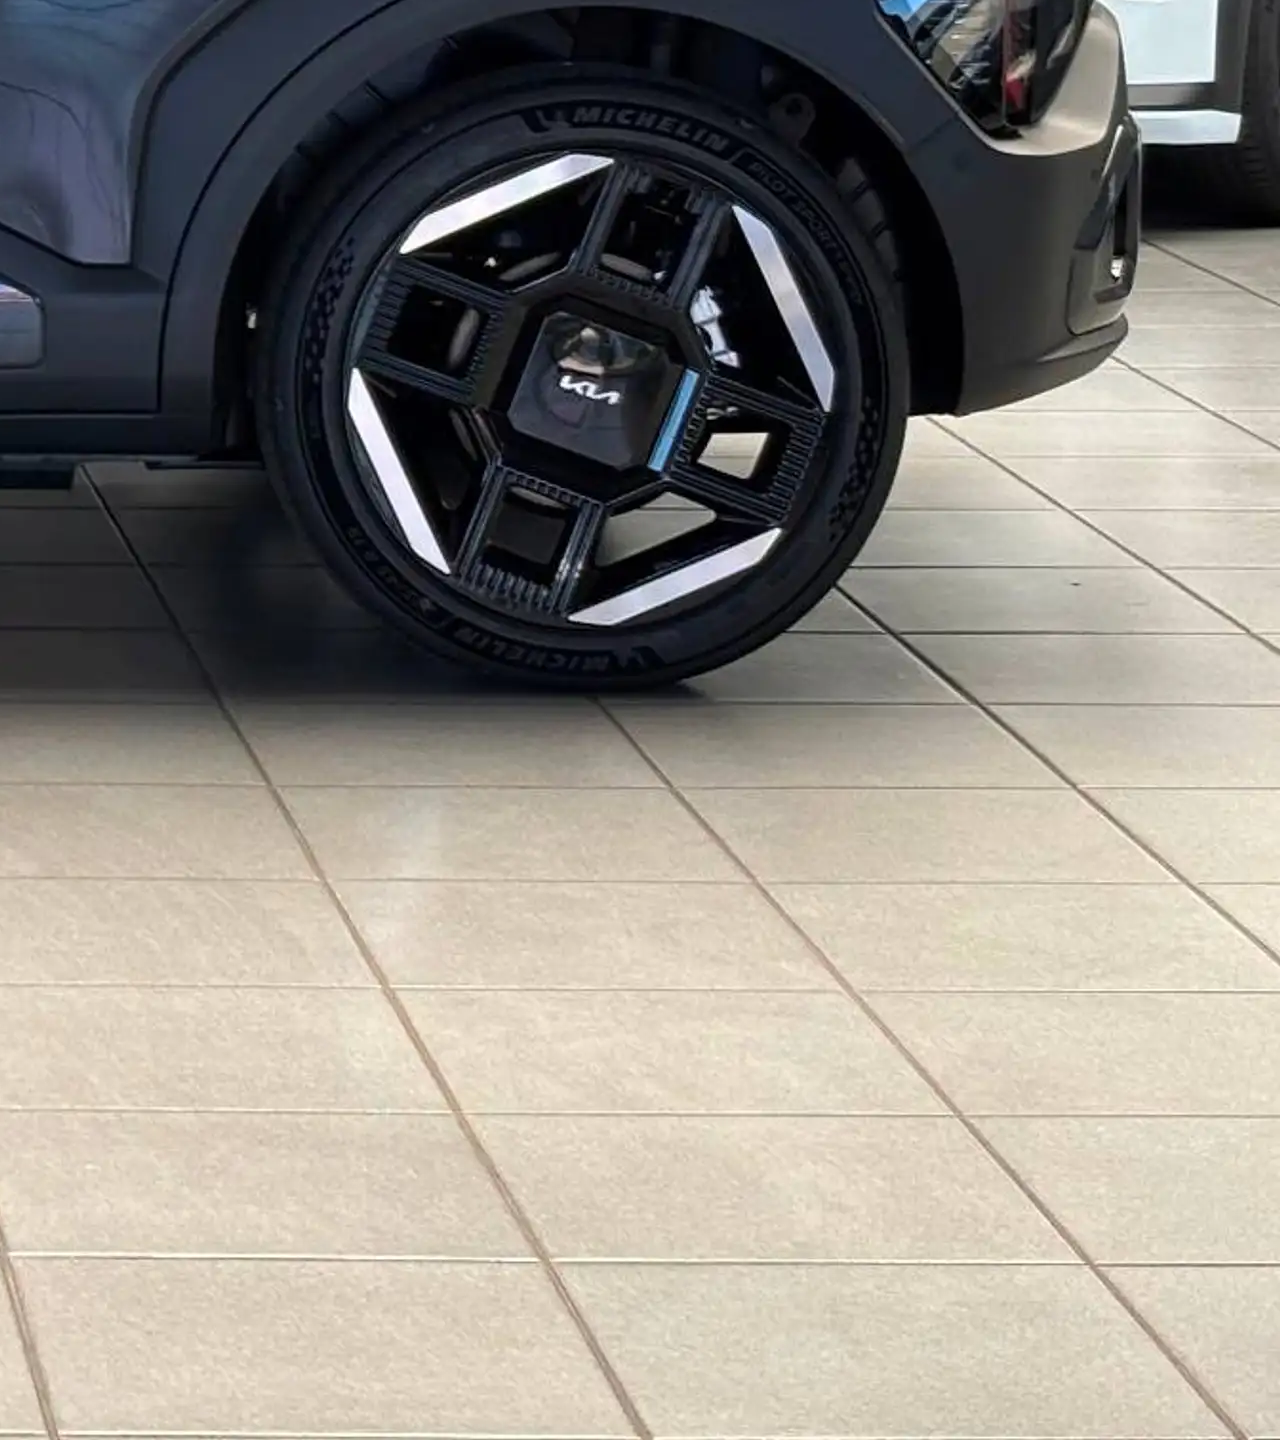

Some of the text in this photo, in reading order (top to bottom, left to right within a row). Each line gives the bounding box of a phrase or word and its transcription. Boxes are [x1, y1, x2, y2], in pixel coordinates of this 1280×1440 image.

[573, 107, 729, 151] MICHELIN
[557, 375, 622, 406] KIA
[453, 626, 610, 671] MICHELIN
